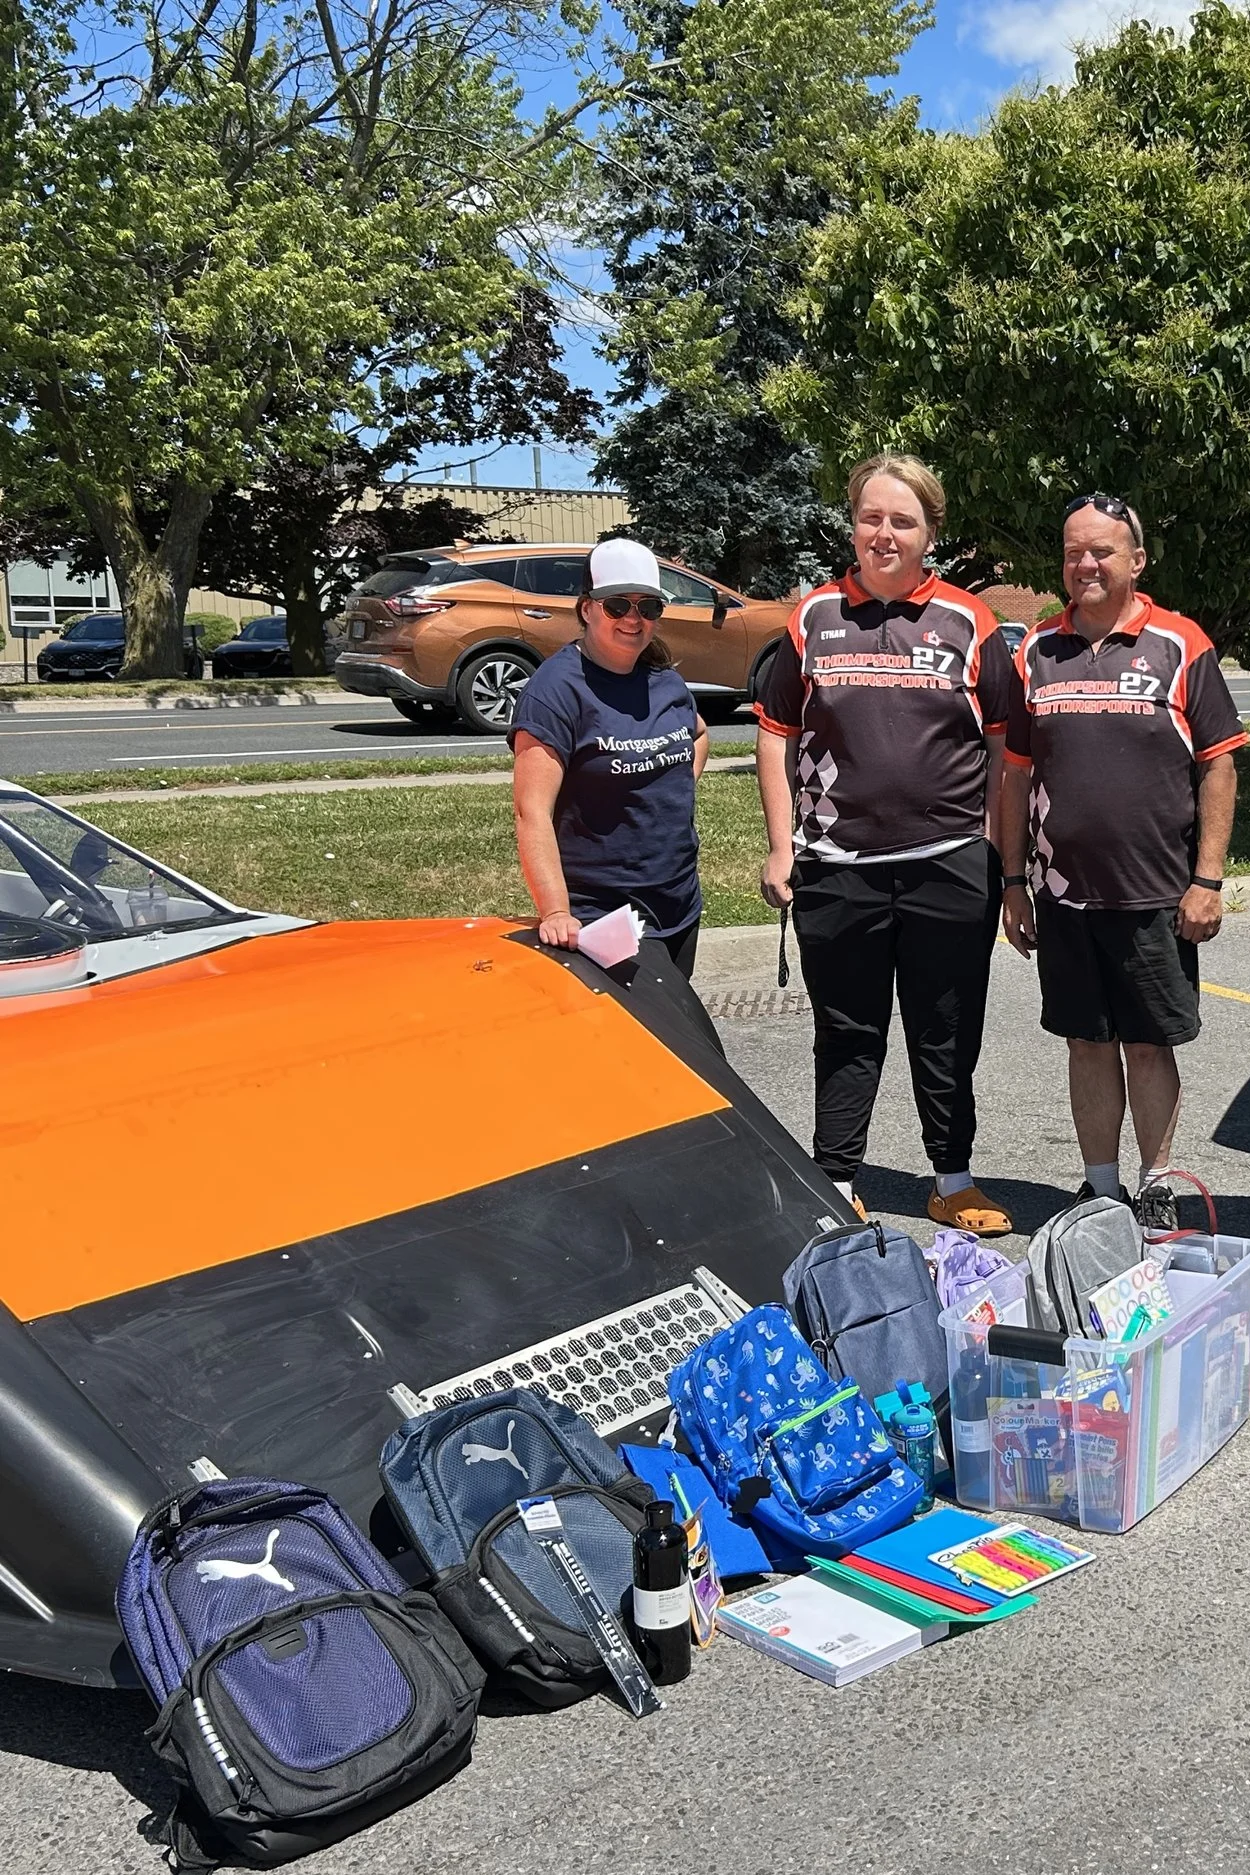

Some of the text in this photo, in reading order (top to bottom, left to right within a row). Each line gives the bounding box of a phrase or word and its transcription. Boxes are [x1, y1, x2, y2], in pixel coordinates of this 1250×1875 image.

[821, 629, 846, 640] ETHAN
[814, 646, 955, 673] THOMPSON 27
[813, 672, 952, 690] MOTORSPORTS
[1034, 672, 1160, 699] THOMPSON 27
[595, 736, 669, 753] Mortgages
[611, 747, 692, 774] Sarah Turck
